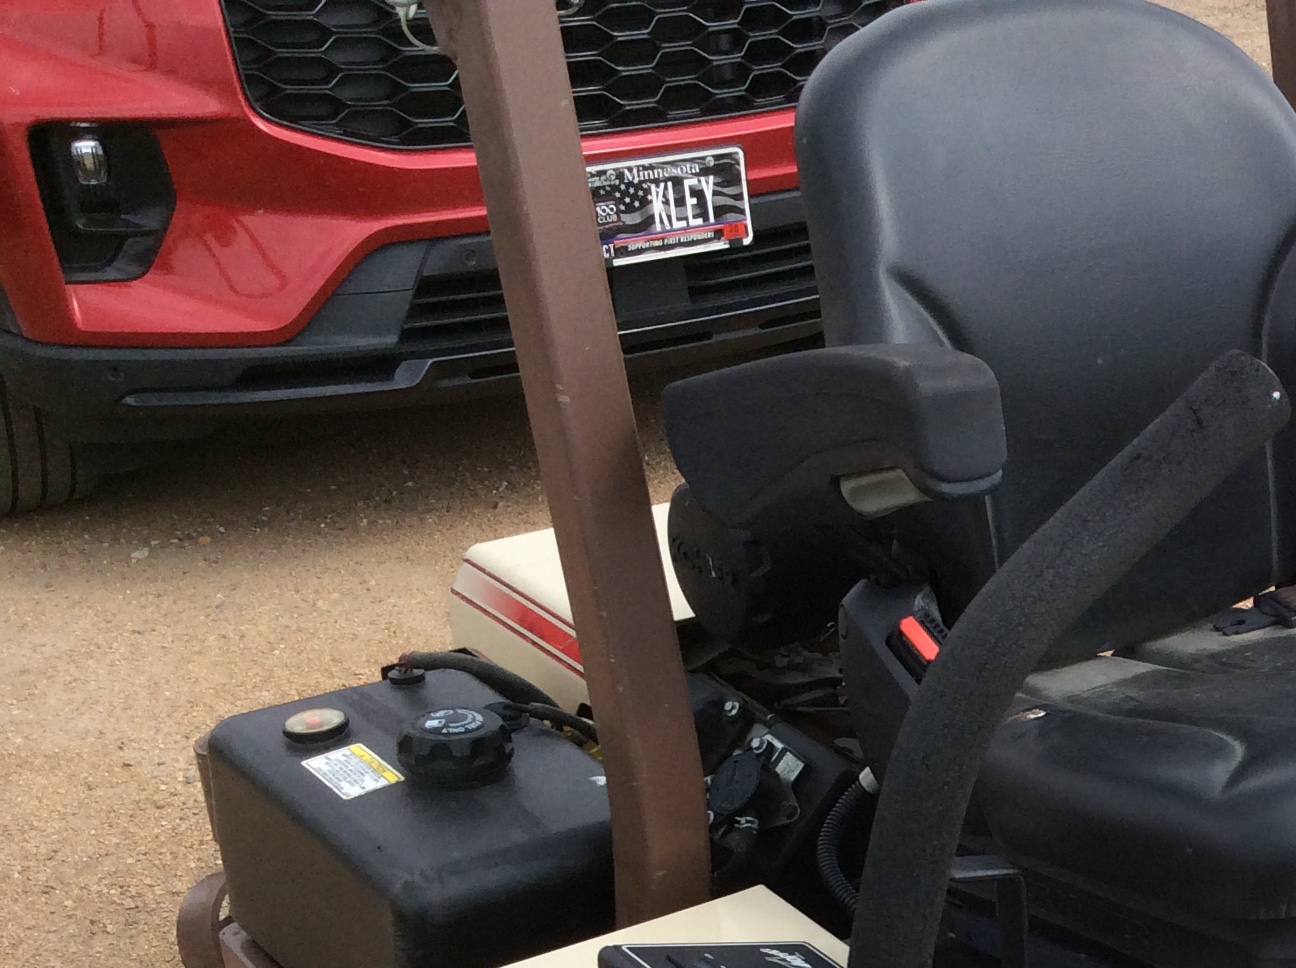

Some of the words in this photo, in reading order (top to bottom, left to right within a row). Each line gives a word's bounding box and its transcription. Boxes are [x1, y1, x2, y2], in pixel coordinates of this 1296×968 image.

[624, 162, 700, 183] Minnesota
[650, 175, 715, 232] KLEY
[597, 214, 618, 223] CLUB
[628, 240, 663, 251] SUPPORTING
[664, 237, 679, 246] FIRST
[680, 231, 715, 243] RESPONDERS
